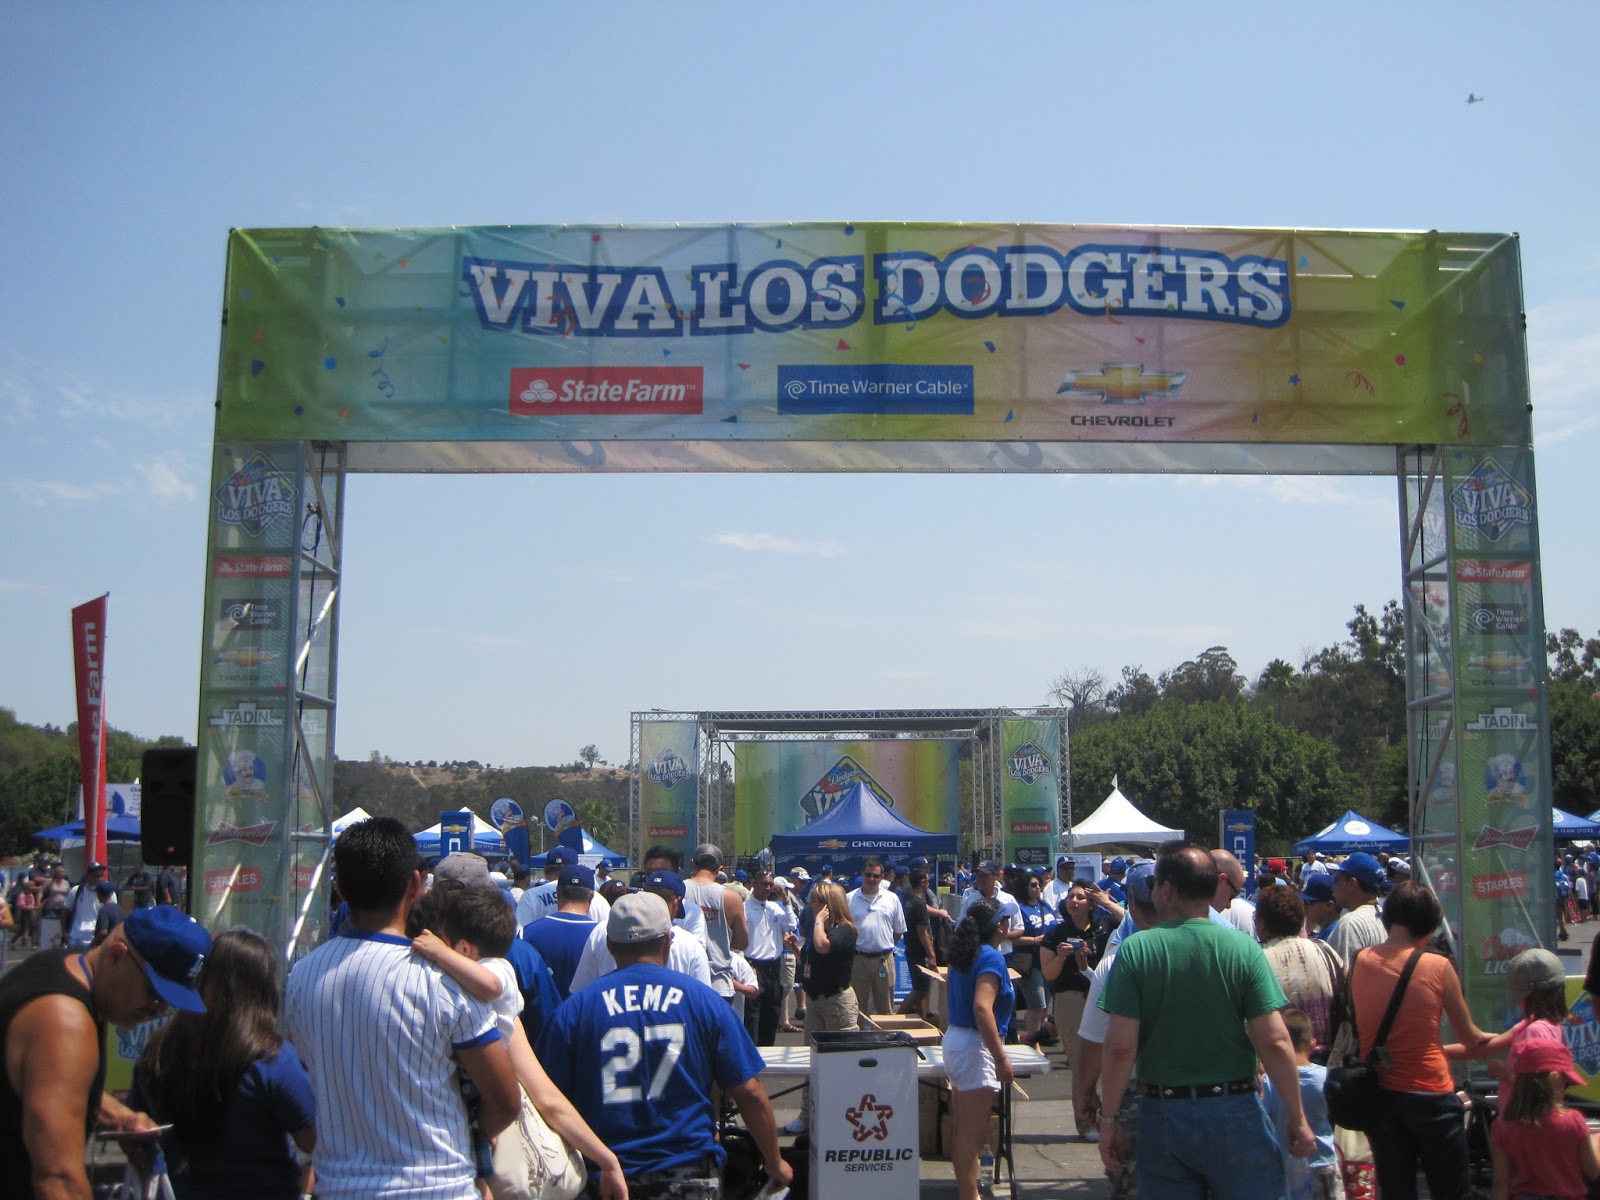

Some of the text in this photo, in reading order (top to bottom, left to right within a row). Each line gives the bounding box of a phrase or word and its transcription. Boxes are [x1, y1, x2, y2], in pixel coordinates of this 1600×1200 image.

[468, 249, 1288, 332] VIVA LOS DODGERS
[808, 379, 962, 395] Time Warner Cable
[1070, 414, 1176, 427] CHEVROLET
[228, 477, 283, 509] VIVA
[1462, 483, 1518, 514] VIVA
[221, 500, 292, 520] LOS DODGERS
[1458, 506, 1529, 526] LOS DODGERS
[250, 603, 268, 611] Time
[249, 617, 270, 625] Cable
[1496, 615, 1523, 623] Warner
[1496, 622, 1518, 630] Cable
[226, 710, 269, 724] TADIN
[1481, 715, 1525, 728] TADIN
[654, 757, 683, 775] VIVA
[1014, 753, 1044, 771] VIVA
[828, 767, 862, 787] Dodgers
[1010, 765, 1049, 777] LOS DODGERS
[209, 873, 257, 888] STALES
[1477, 876, 1523, 893] STAPLES
[601, 984, 684, 1017] KEMP
[601, 1023, 686, 1105] 27
[825, 1148, 913, 1162] REPUBLIC
[844, 1162, 894, 1173] SERVICES
